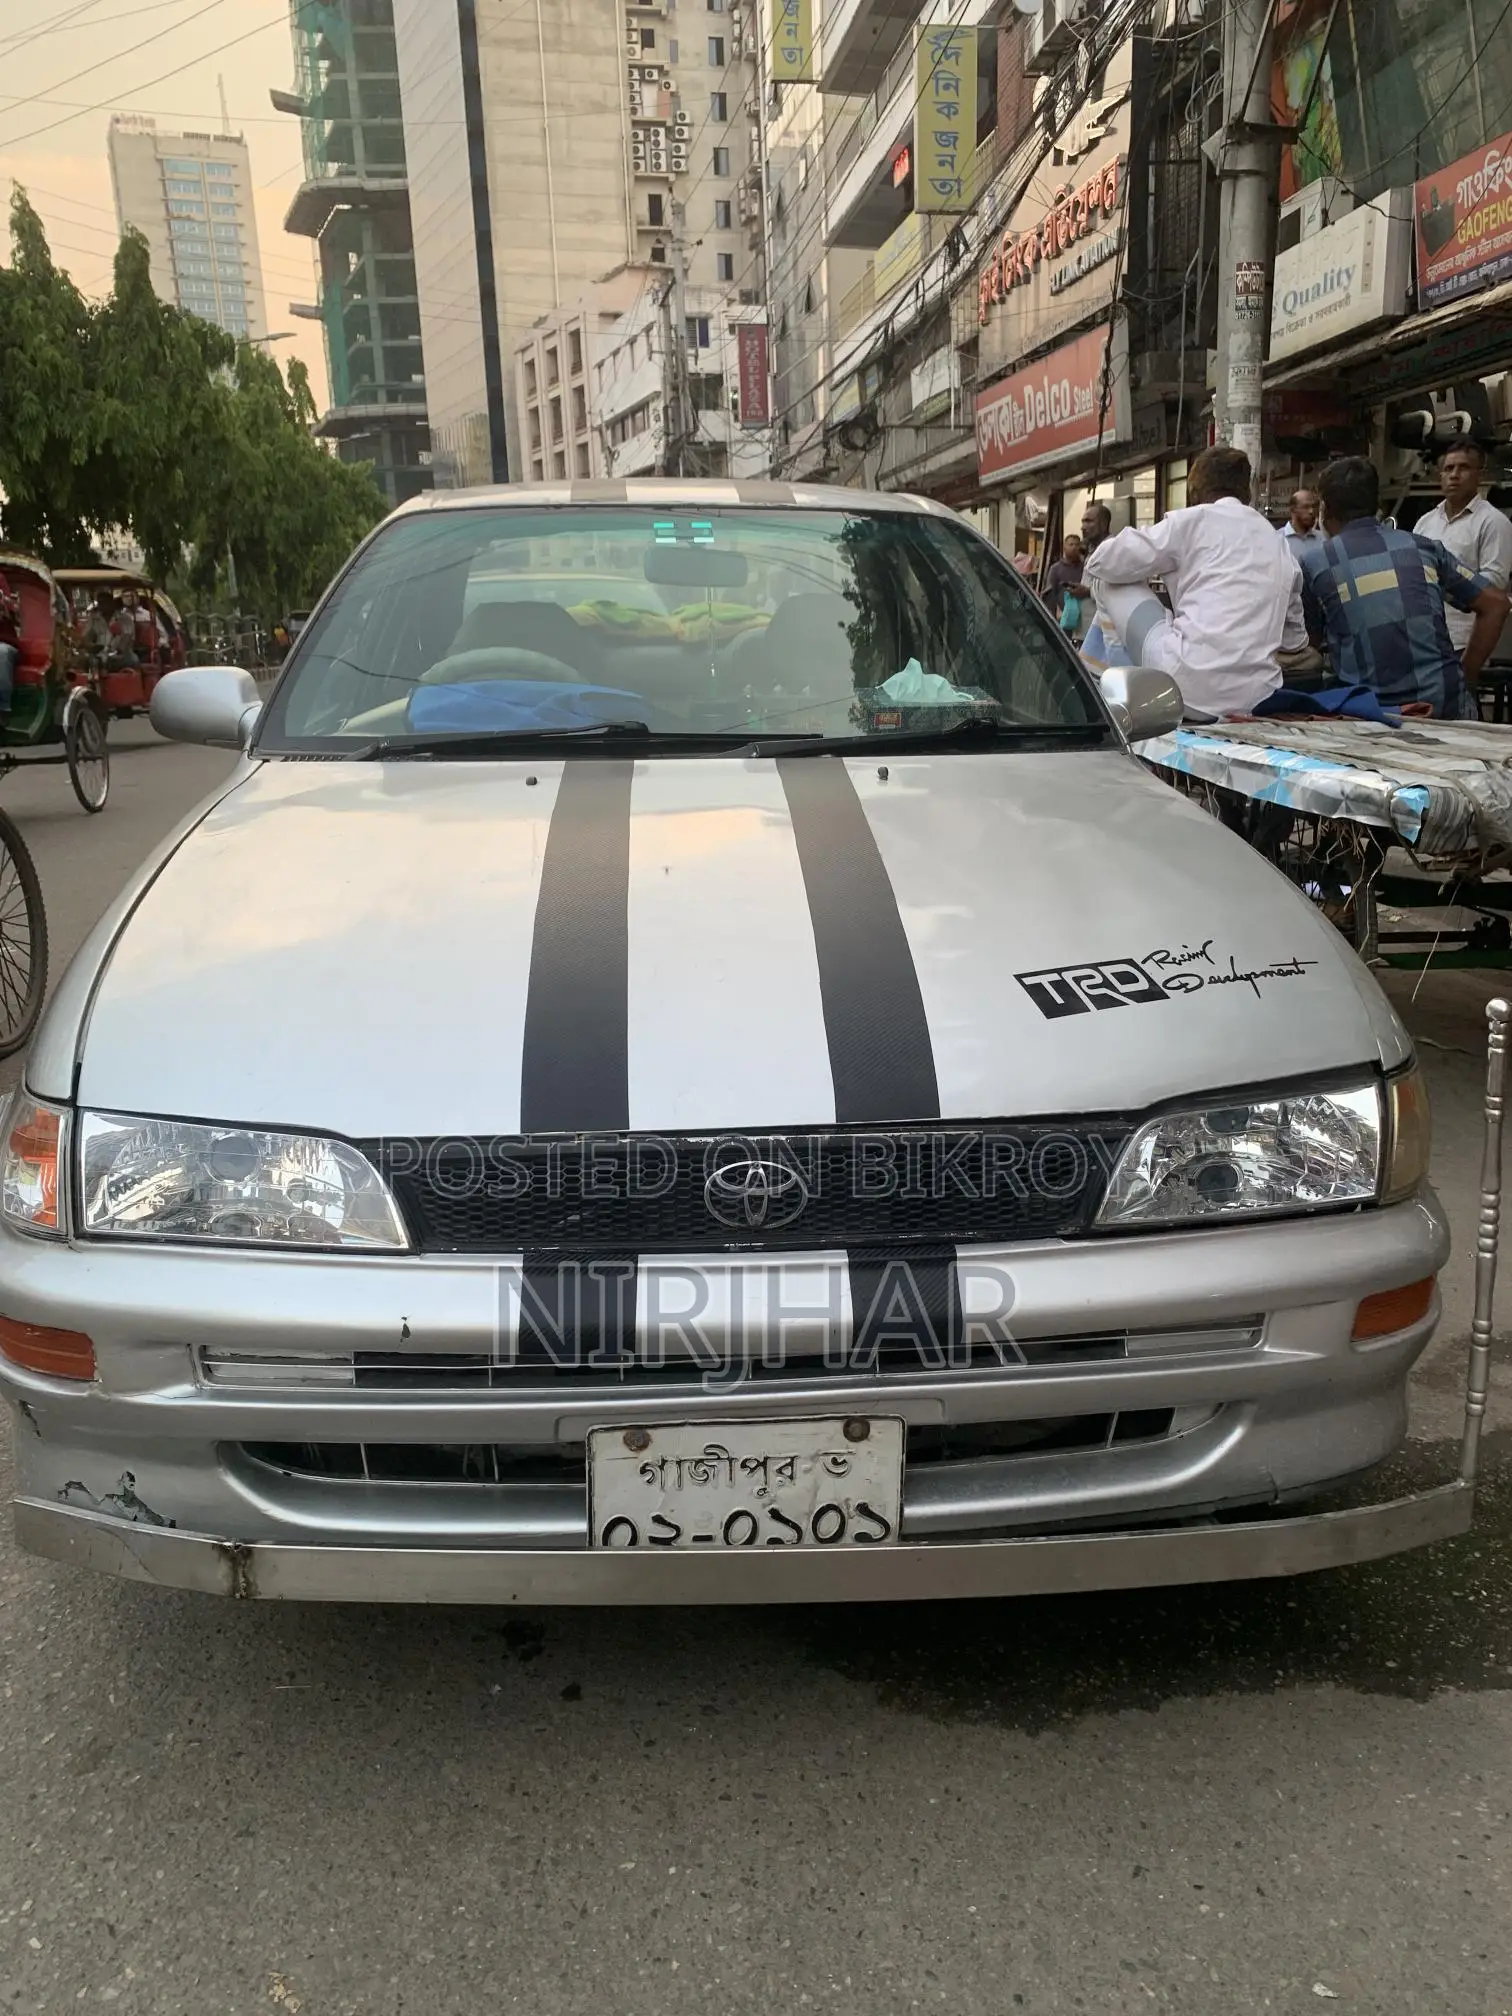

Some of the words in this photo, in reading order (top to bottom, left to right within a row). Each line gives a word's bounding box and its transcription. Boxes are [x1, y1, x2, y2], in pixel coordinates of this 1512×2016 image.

[928, 28, 973, 121] দৈনিক
[928, 130, 964, 198] জনতা
[1457, 194, 1512, 245] GAOFENG
[1282, 263, 1357, 317] Quality
[1024, 375, 1071, 432] Delco
[1073, 378, 1094, 415] Steel
[1016, 960, 1165, 1015] TRD
[639, 1443, 800, 1499] গাজীপুর
